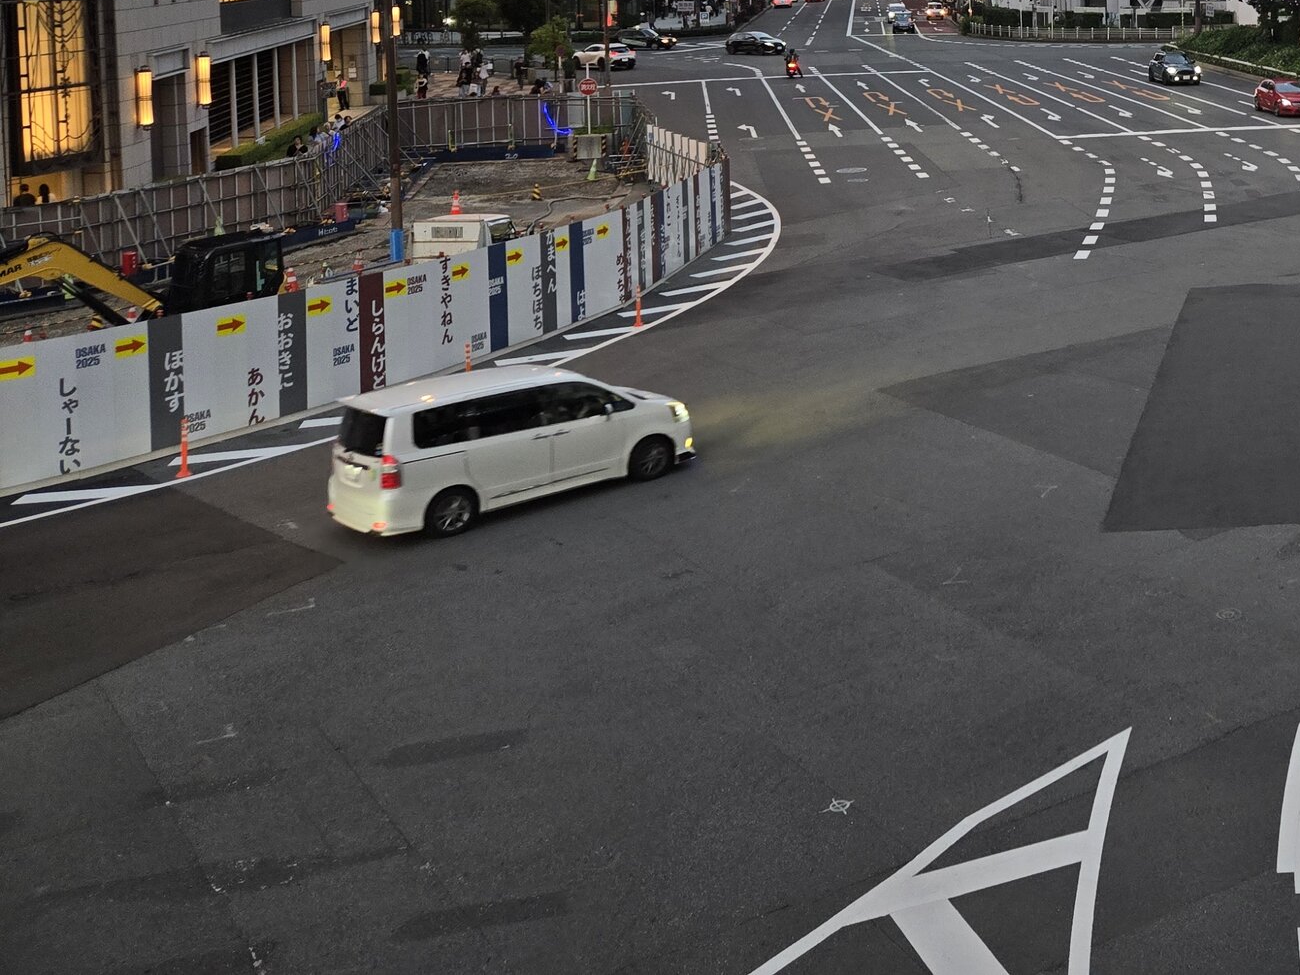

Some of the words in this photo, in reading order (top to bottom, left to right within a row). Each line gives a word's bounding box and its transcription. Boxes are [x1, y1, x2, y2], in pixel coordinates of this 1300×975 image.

[407, 273, 427, 287] OSAKA
[616, 252, 627, 305] めっちゃ
[407, 284, 424, 296] 2025
[345, 277, 360, 332] まいど
[439, 256, 454, 345] すきやねん
[370, 300, 387, 389] しらんけど
[471, 331, 488, 344] OSAKA
[75, 343, 106, 360] OSAKA
[278, 312, 294, 390] おおきに
[333, 343, 355, 358] OSAKA
[471, 341, 485, 353] 2025
[76, 354, 101, 369] 2025
[332, 353, 351, 367] 2025
[247, 367, 266, 427] あかん
[58, 377, 81, 475] しゃーない
